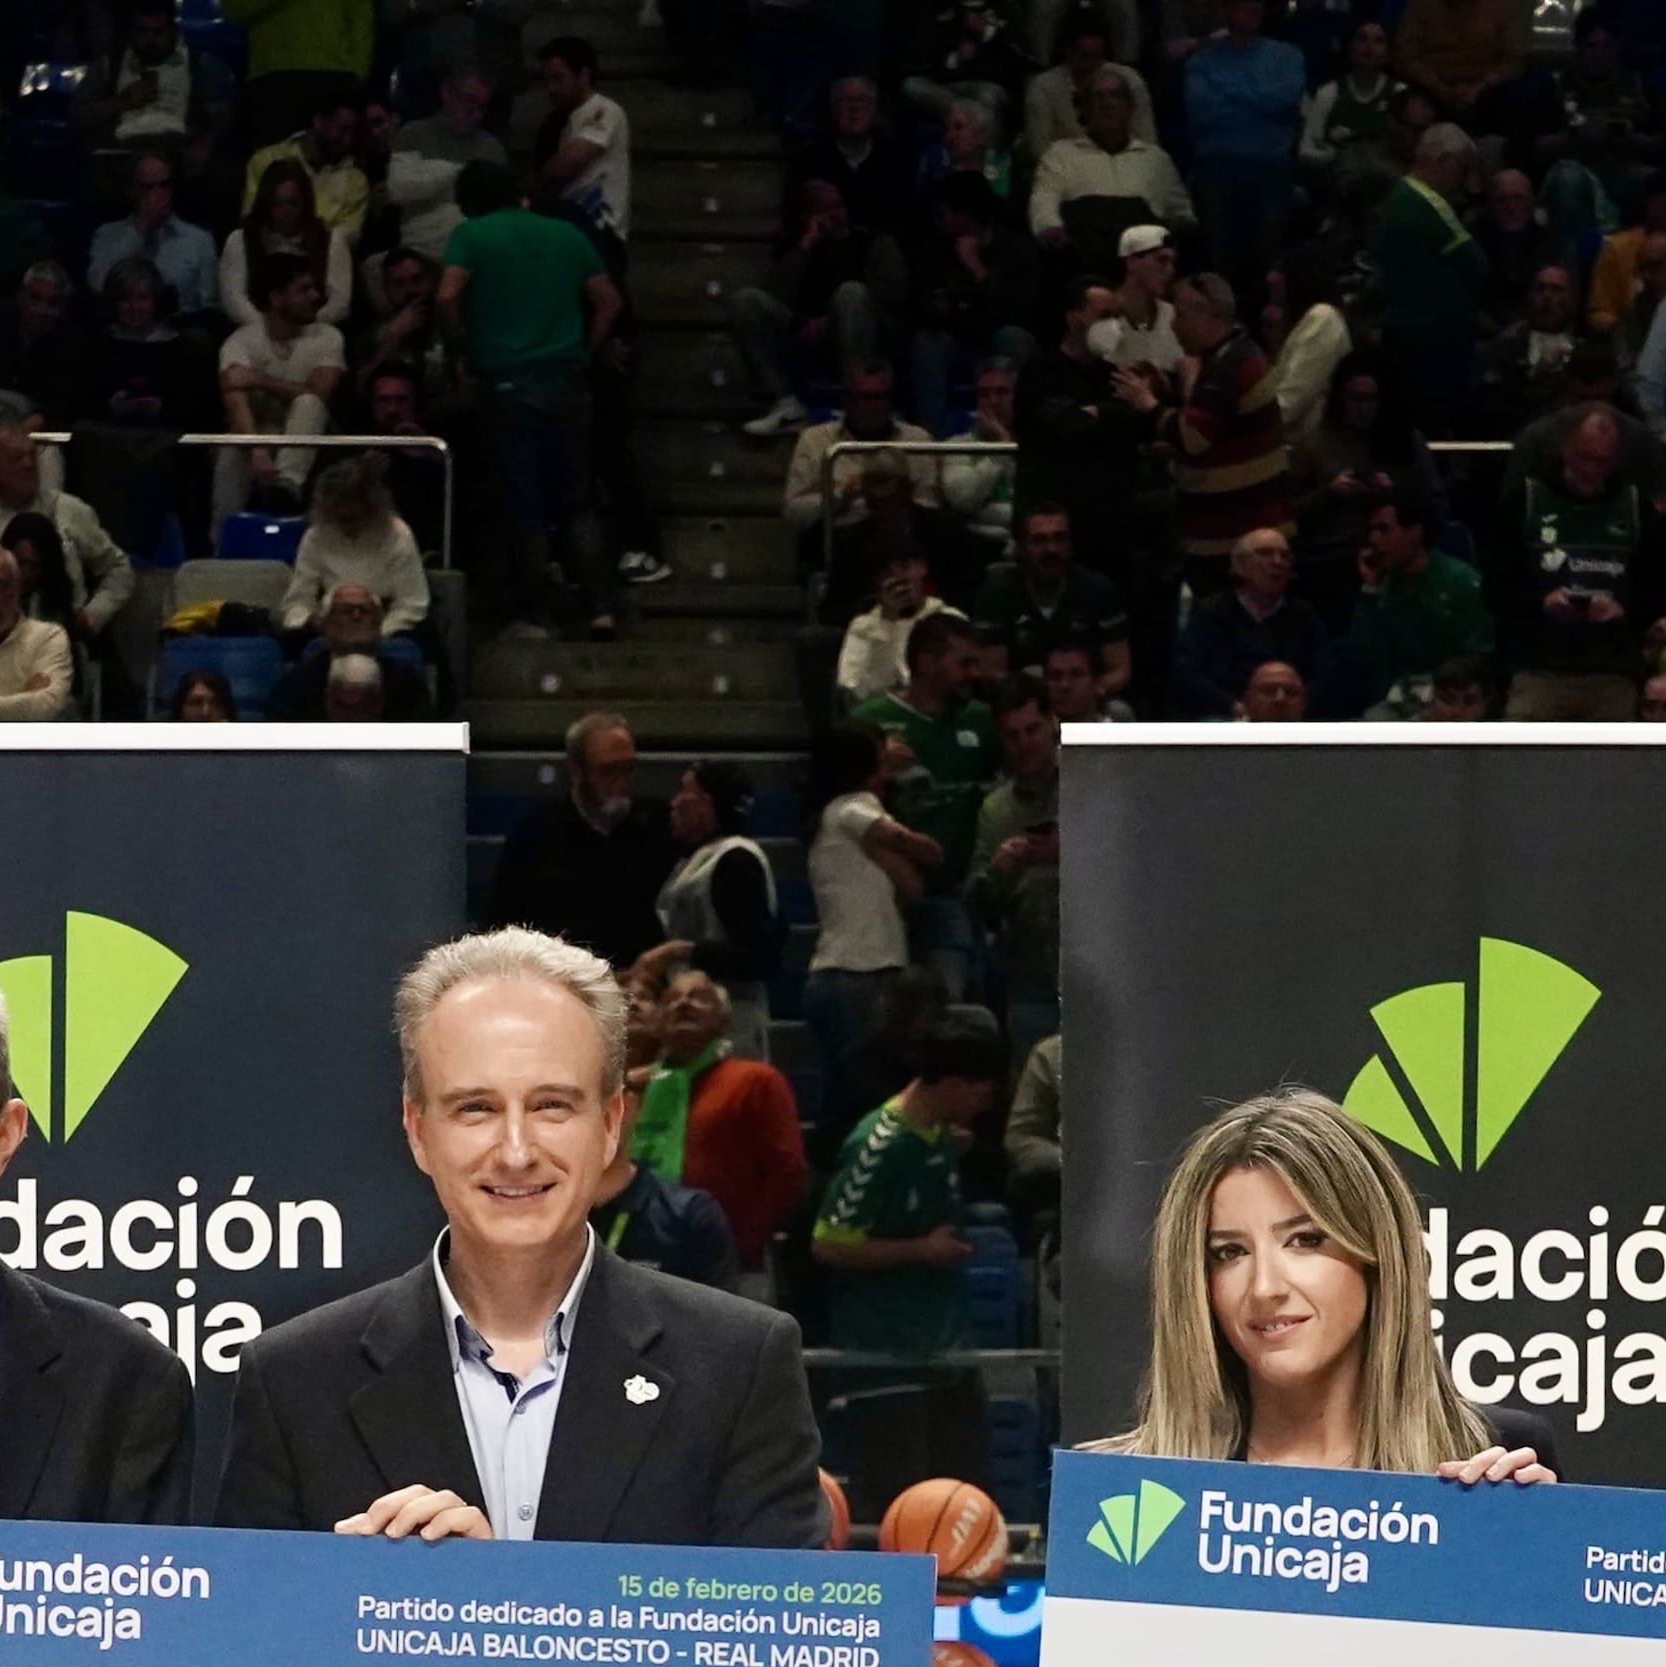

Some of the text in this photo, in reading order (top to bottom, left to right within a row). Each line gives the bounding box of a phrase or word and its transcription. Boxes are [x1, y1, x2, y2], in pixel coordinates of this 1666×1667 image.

[1200, 1490, 1438, 1544] Fundación
[1198, 1533, 1368, 1592] Unicaja
[619, 1575, 881, 1605] 15 de febrero de 2026
[358, 1595, 879, 1643] Partido dedicado a la Fundación Unicaja
[357, 1628, 476, 1656] UNICAJA
[483, 1633, 669, 1664] BALONCESTO
[695, 1641, 764, 1667] REAL
